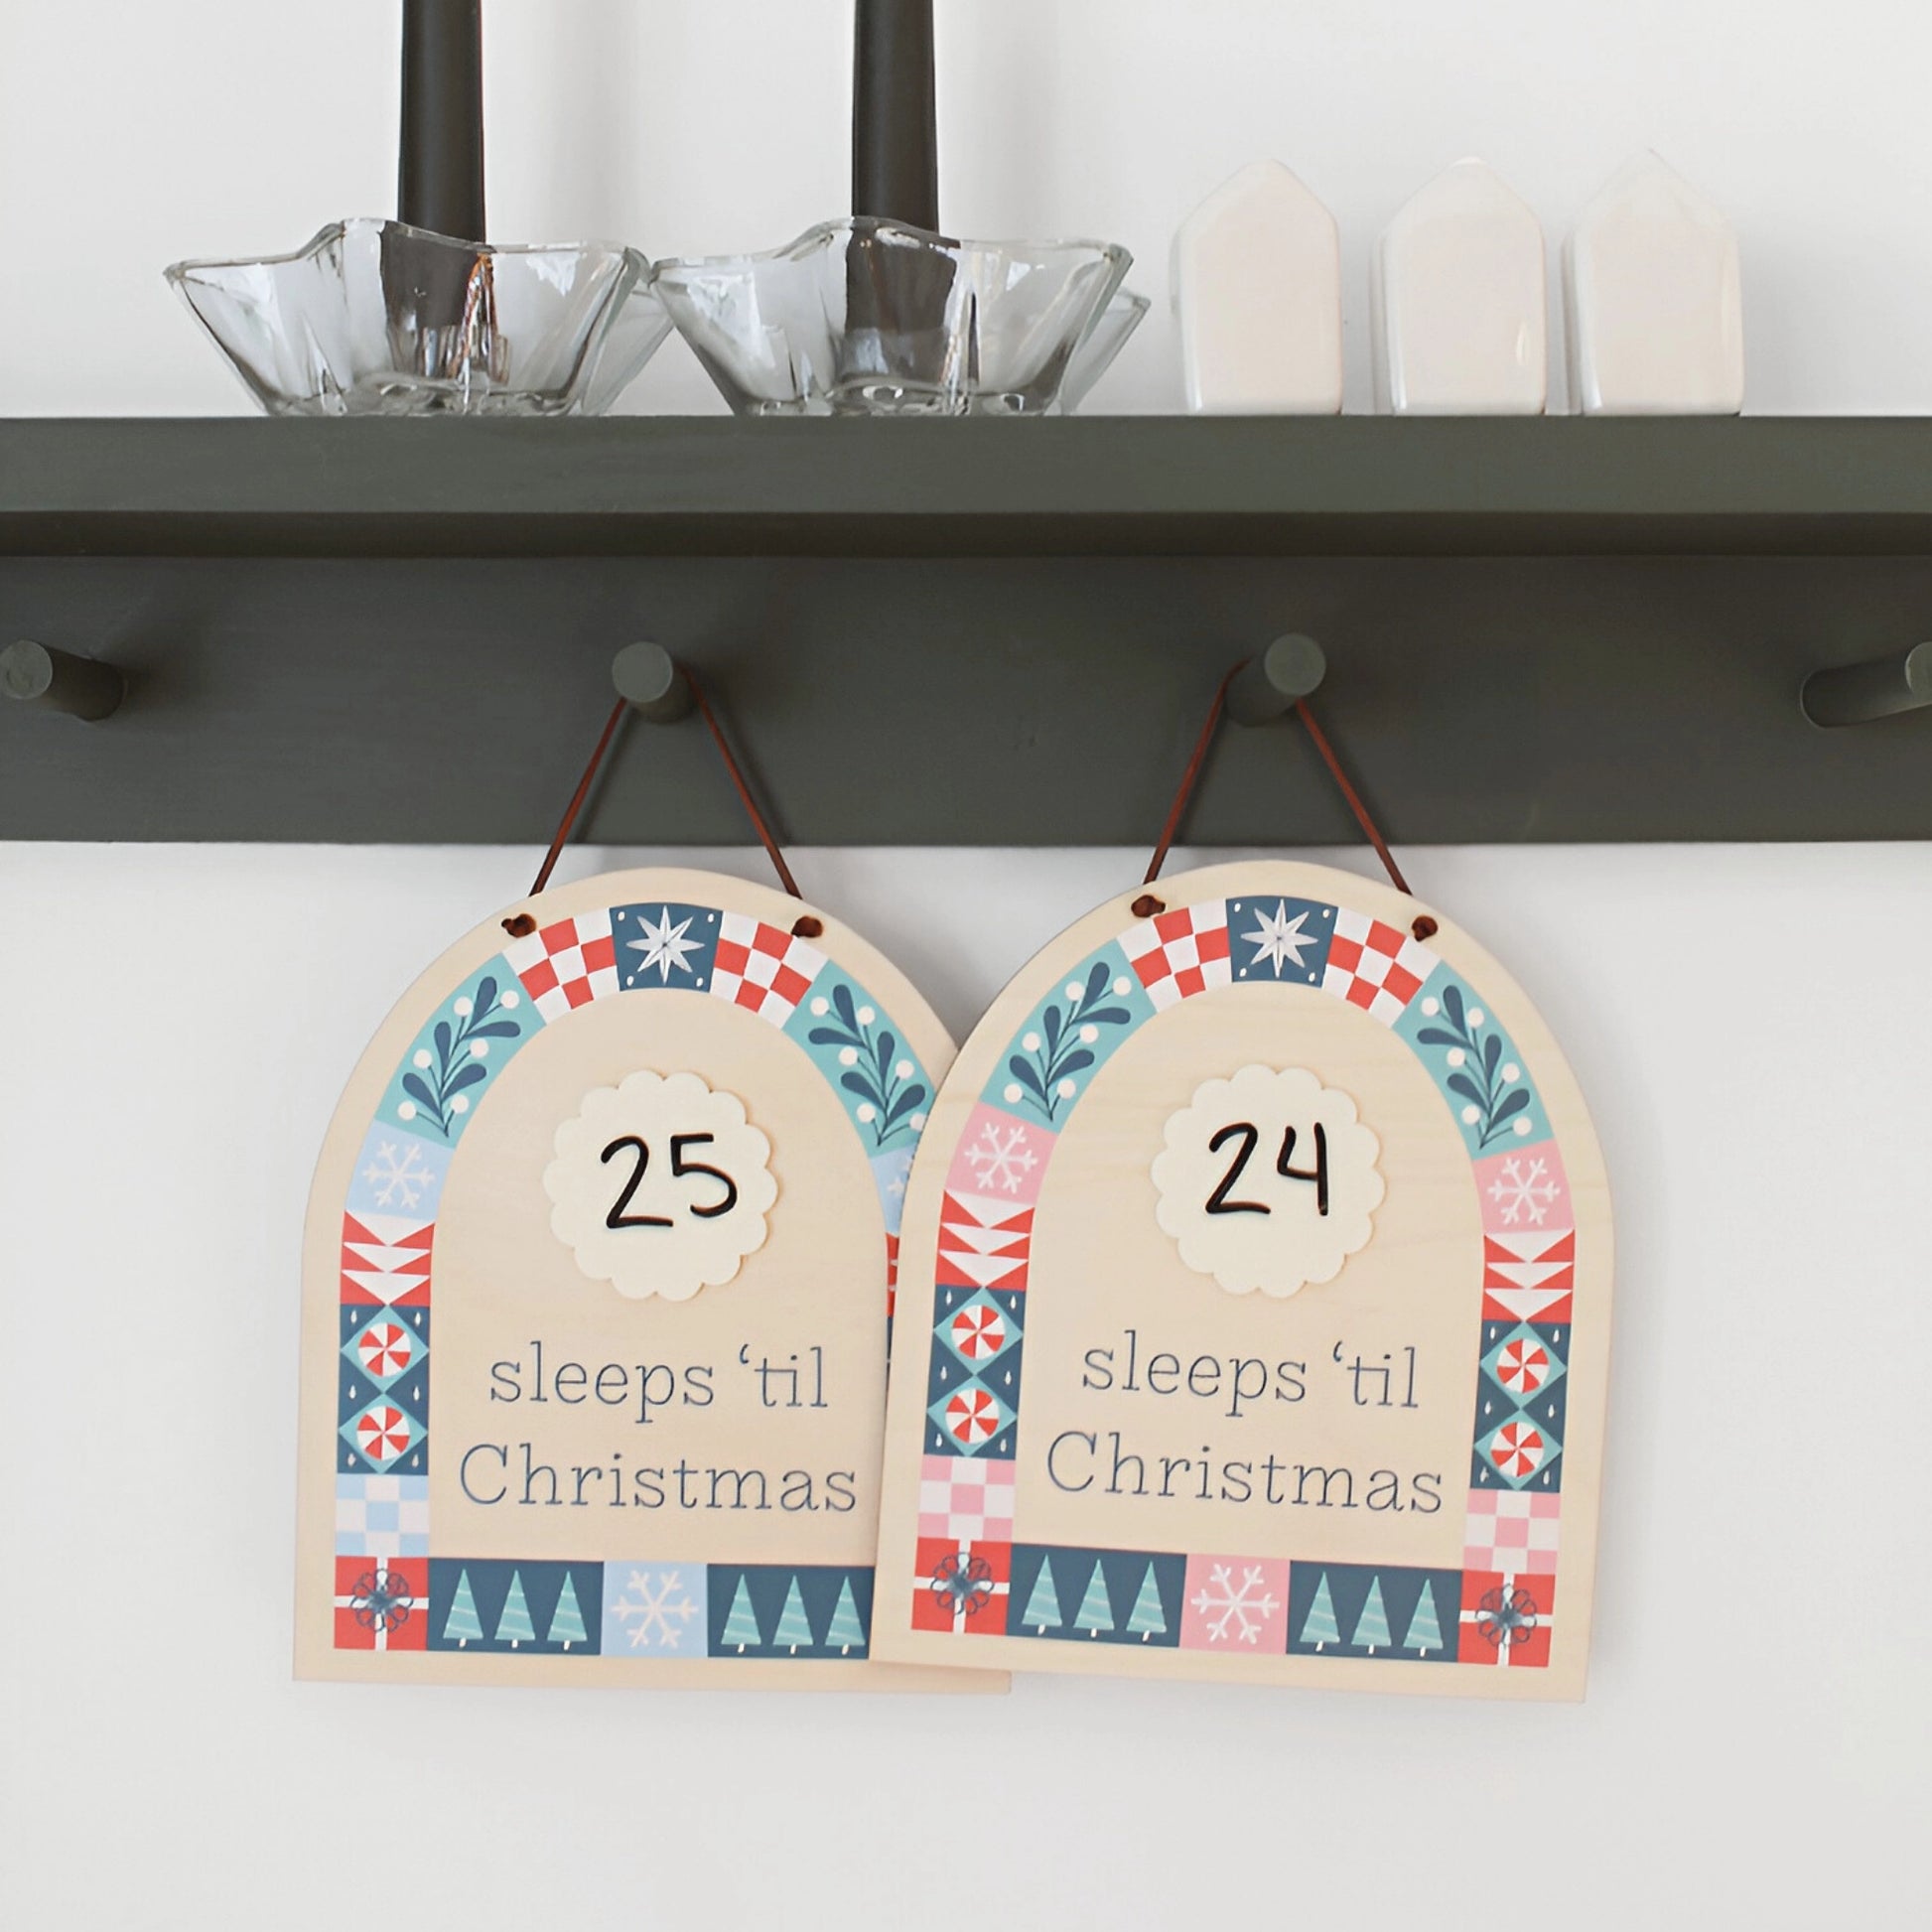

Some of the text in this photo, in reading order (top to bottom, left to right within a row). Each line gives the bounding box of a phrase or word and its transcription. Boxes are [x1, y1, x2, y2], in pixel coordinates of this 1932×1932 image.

[601, 1132, 738, 1229] 25
[1205, 1122, 1329, 1216] 24
[490, 1340, 715, 1425] sleeps
[1083, 1329, 1307, 1417] sleeps
[461, 1443, 857, 1513] Christmas
[1047, 1431, 1443, 1514] Christmas
